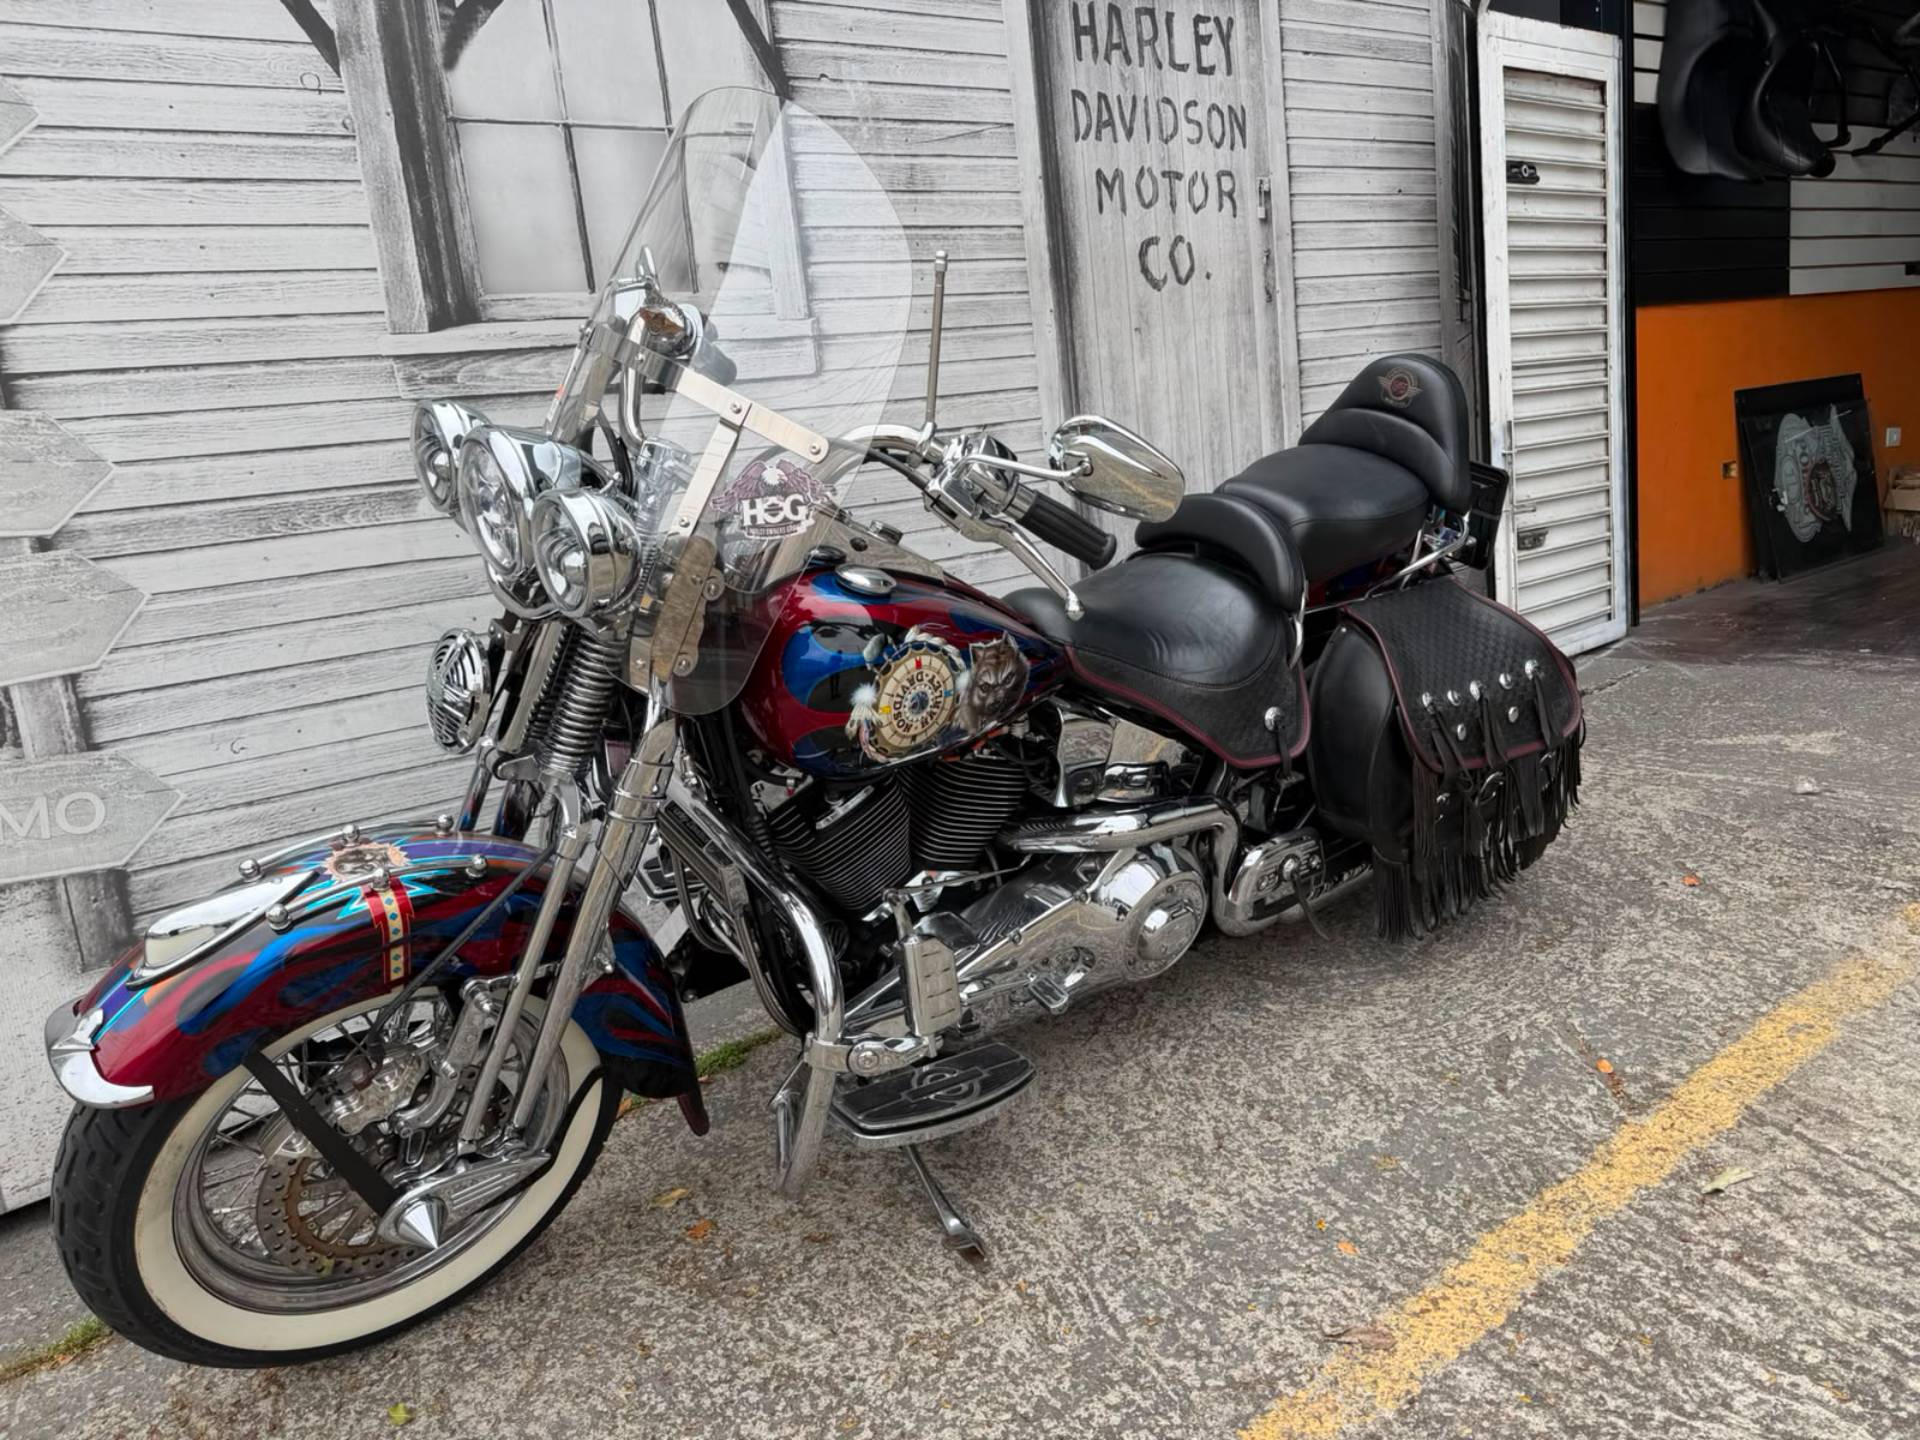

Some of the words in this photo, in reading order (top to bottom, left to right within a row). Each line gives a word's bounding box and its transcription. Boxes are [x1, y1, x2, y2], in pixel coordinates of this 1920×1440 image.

[1072, 0, 1234, 76] HARLEY
[1071, 89, 1247, 151] DAVIDSON
[1095, 165, 1237, 218] MOTOR
[1138, 234, 1212, 292] CO.
[741, 493, 808, 526] HOG
